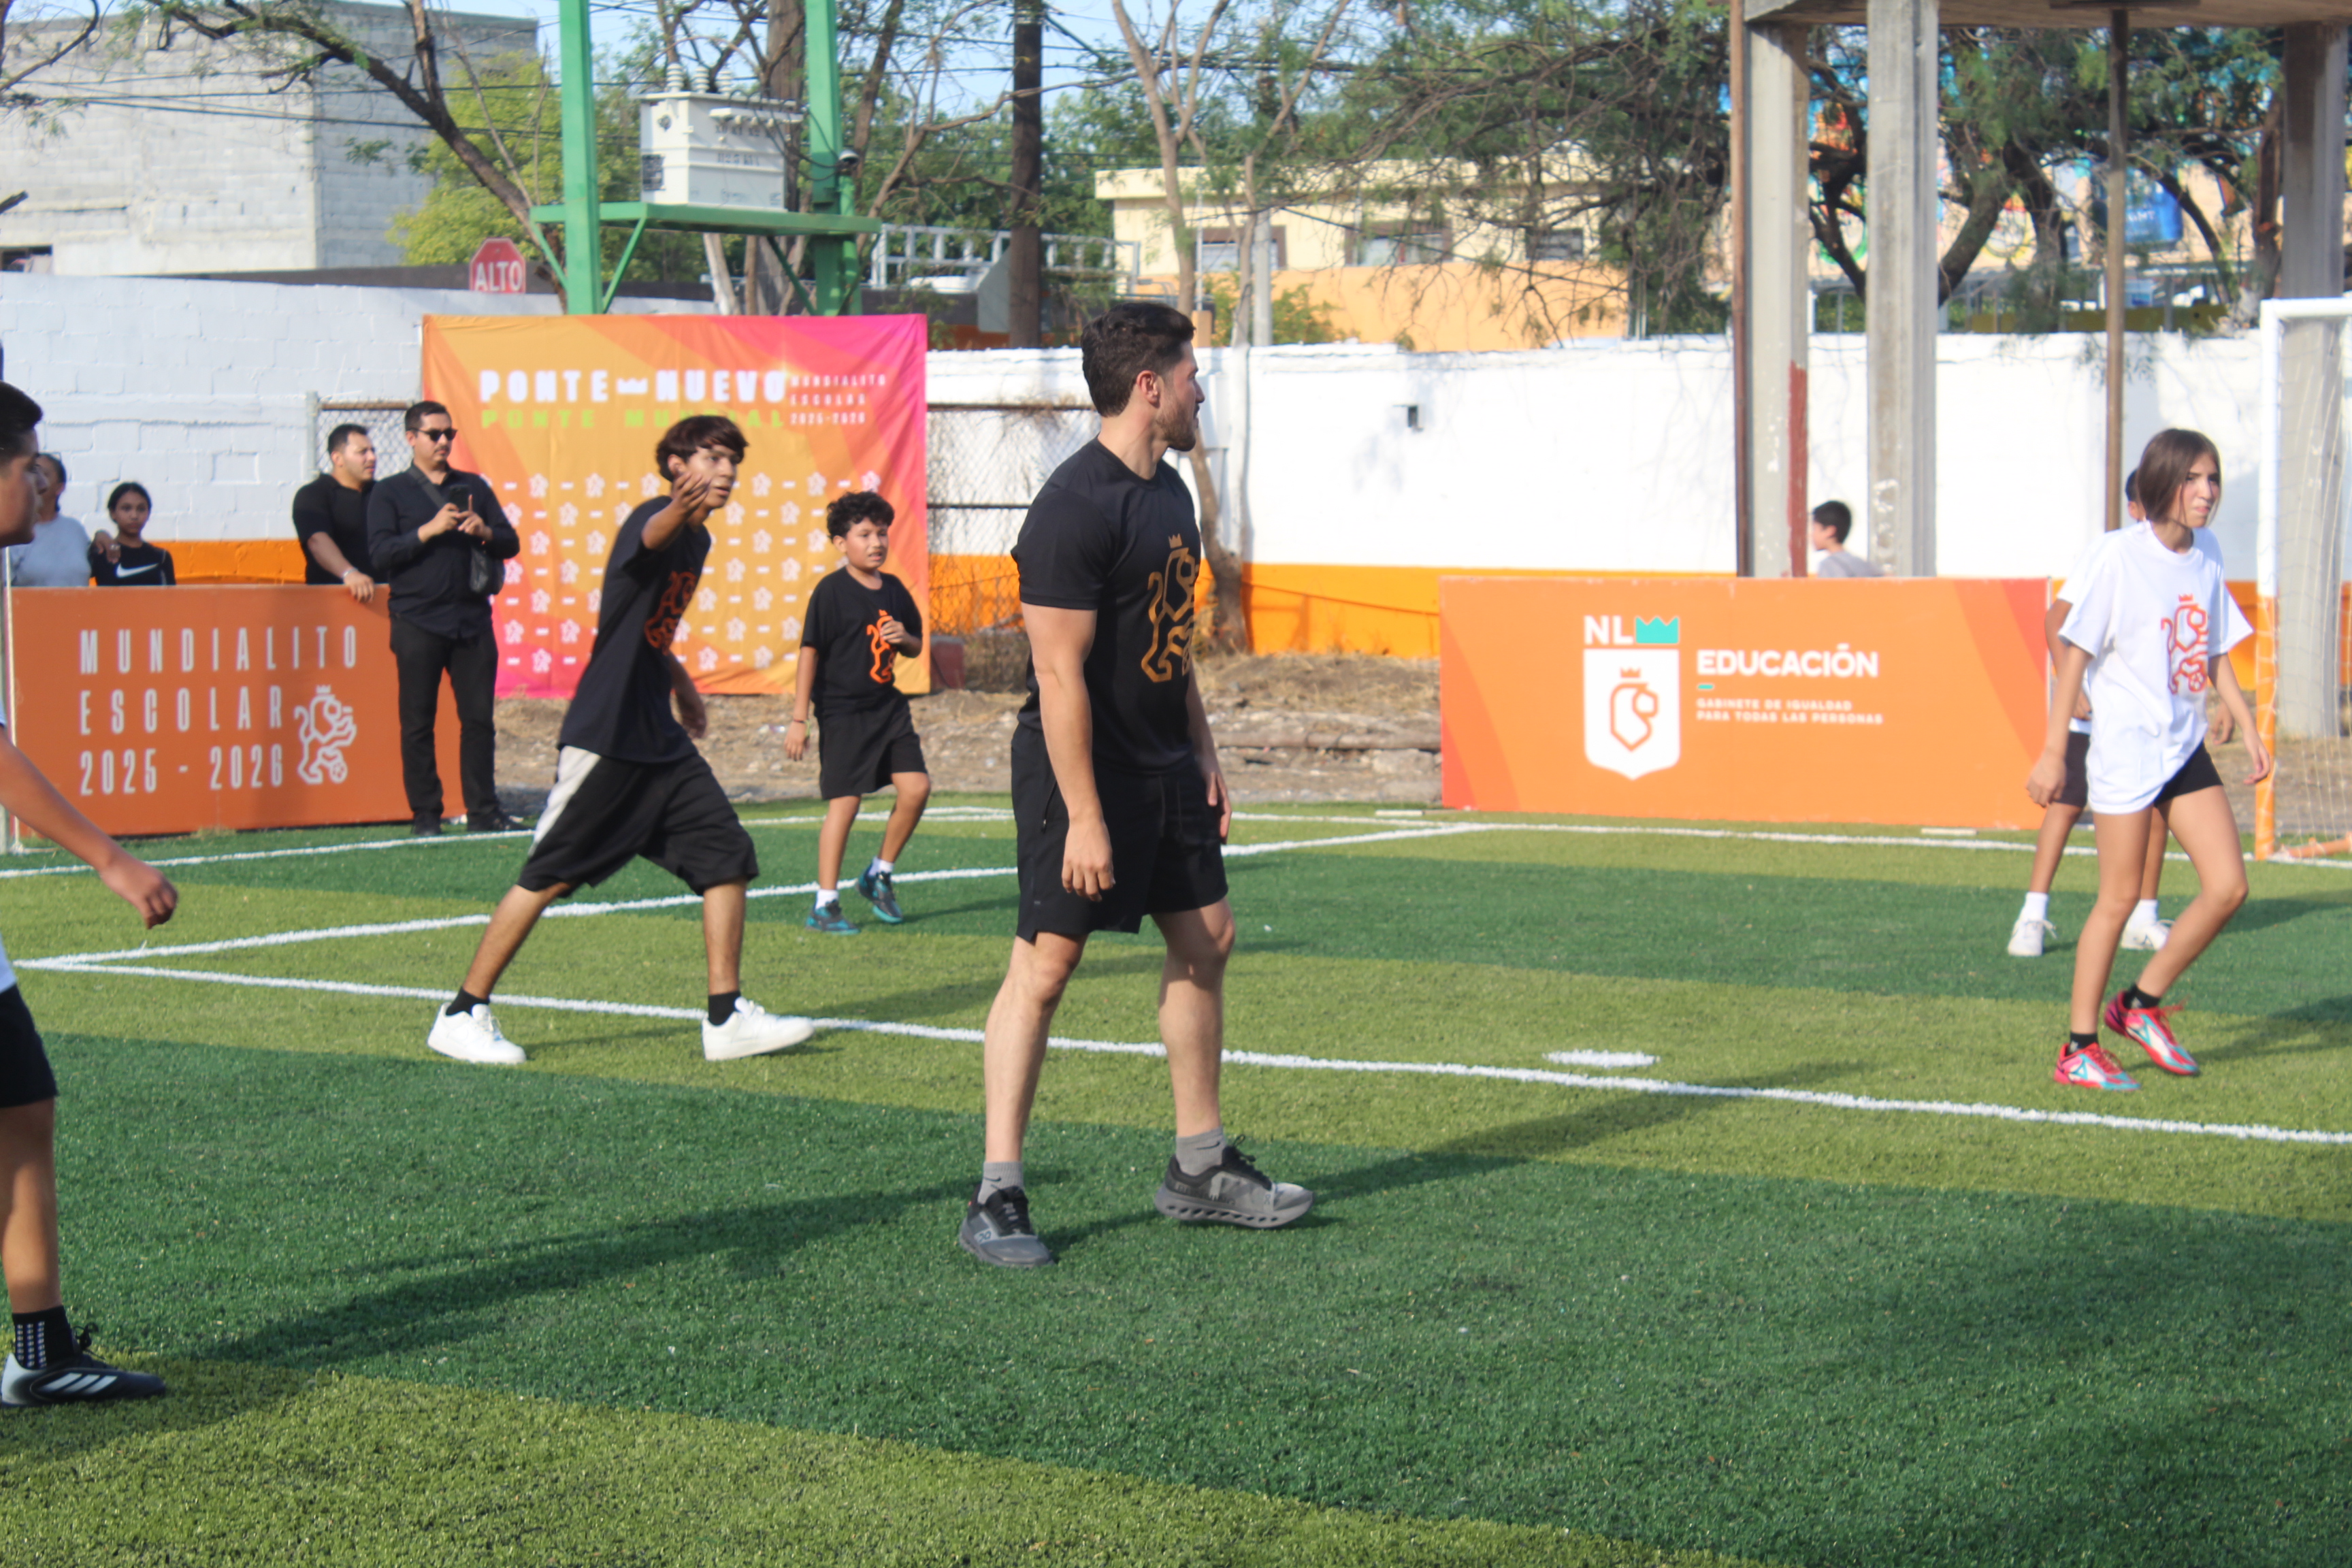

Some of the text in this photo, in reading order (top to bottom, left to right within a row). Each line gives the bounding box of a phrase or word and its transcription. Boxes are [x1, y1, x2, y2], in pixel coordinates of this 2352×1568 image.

[474, 260, 523, 292] ALTO
[480, 369, 785, 403] PONTE NUEVO
[482, 409, 783, 428] PONTE MUIAL
[1584, 615, 1633, 645] NL
[80, 625, 356, 674] MUNDIALITO
[1697, 643, 1878, 678] EDUCACIÓN
[80, 685, 282, 736] ESCOLAR
[1696, 698, 1852, 712] GABINETE DE IGUALDAD
[1696, 709, 1883, 725] PARA TODAS LAS PERSONAS
[80, 748, 157, 796] 2025
[210, 744, 283, 791] 2026
